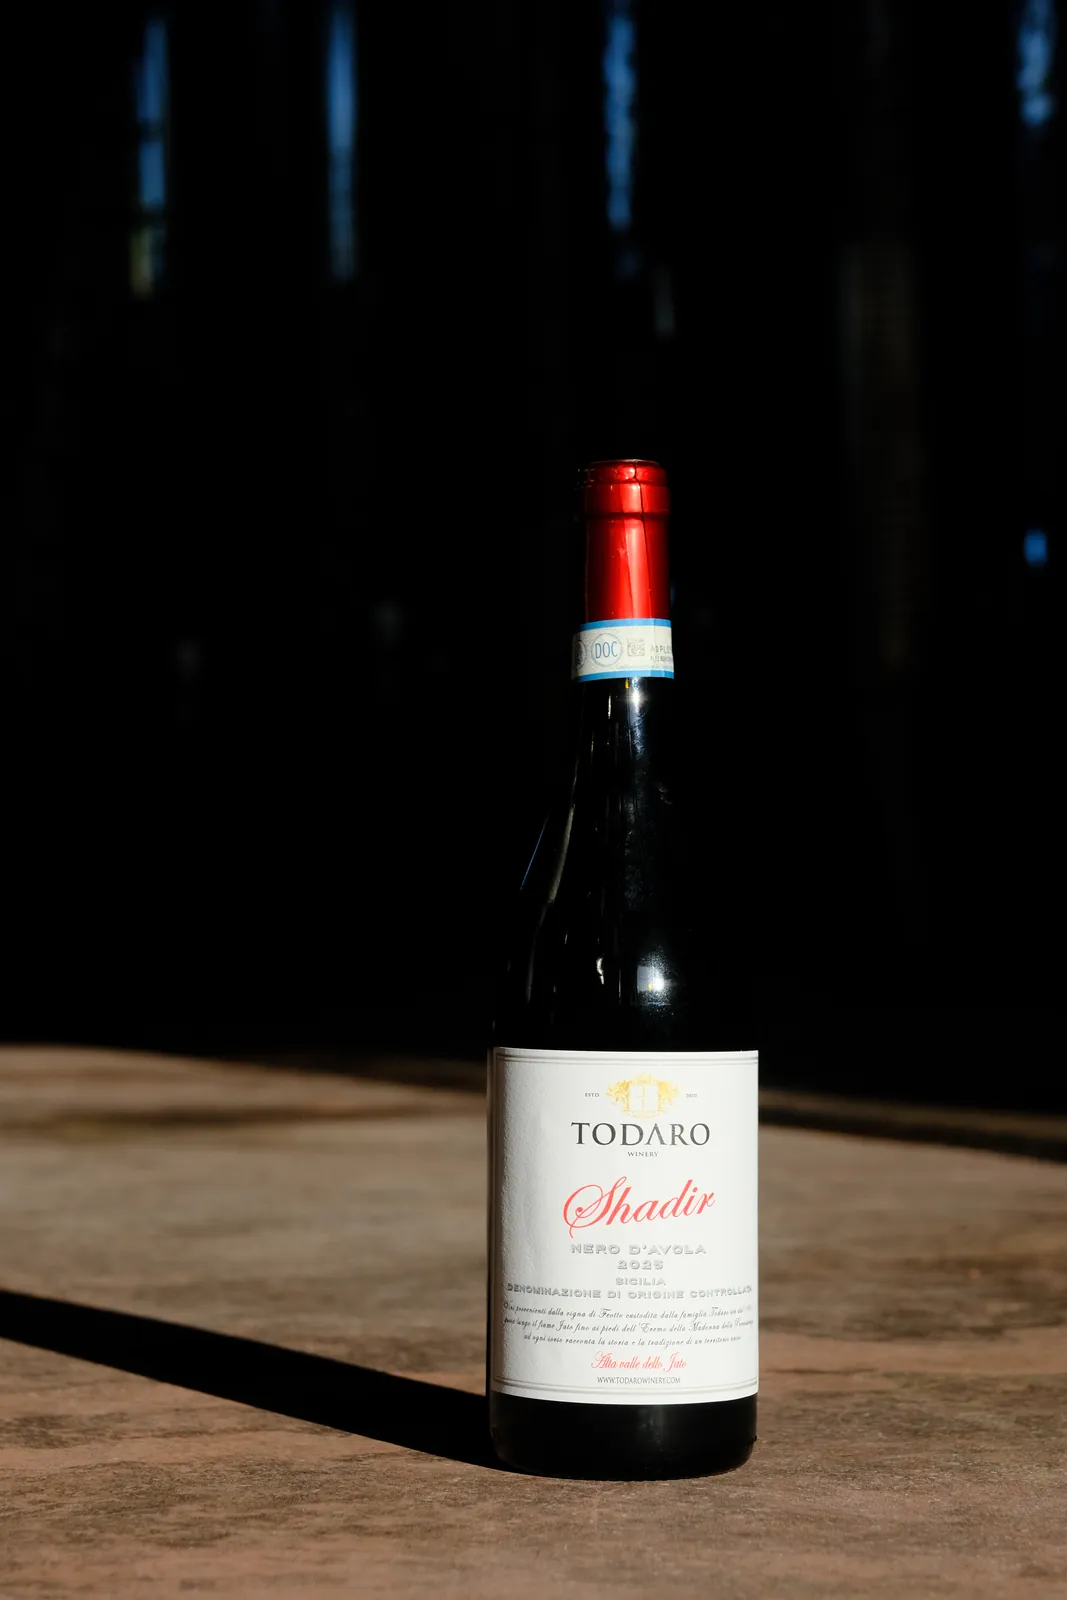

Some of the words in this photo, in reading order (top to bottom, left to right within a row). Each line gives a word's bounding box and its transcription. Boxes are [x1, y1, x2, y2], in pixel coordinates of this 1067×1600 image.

[595, 641, 618, 658] DOC
[571, 1122, 711, 1146] TODARO
[562, 1175, 716, 1239] Shadir
[571, 1243, 620, 1255] NERO
[629, 1244, 707, 1255] D'AVOLA
[617, 1260, 664, 1270] 2025
[615, 1277, 666, 1286] SICILIA
[507, 1282, 601, 1298] DENOMINAZIONE
[607, 1290, 621, 1298] DI
[627, 1290, 684, 1299] ORIGINE
[566, 1311, 586, 1320] vigna
[660, 1310, 678, 1319] dalla
[677, 1310, 707, 1321] famiglia
[573, 1323, 590, 1333] fino
[600, 1324, 620, 1334] piedi
[669, 1323, 686, 1332] della
[532, 1336, 546, 1344] ogni
[598, 1337, 605, 1346] la
[608, 1338, 629, 1346] storia
[647, 1338, 684, 1349] tradizione
[685, 1337, 692, 1345] di
[591, 1351, 618, 1369] Alta
[618, 1354, 641, 1370] valle
[663, 1351, 687, 1372] Jato
[597, 1376, 681, 1384] WWW.TODAROWINERY.COM
